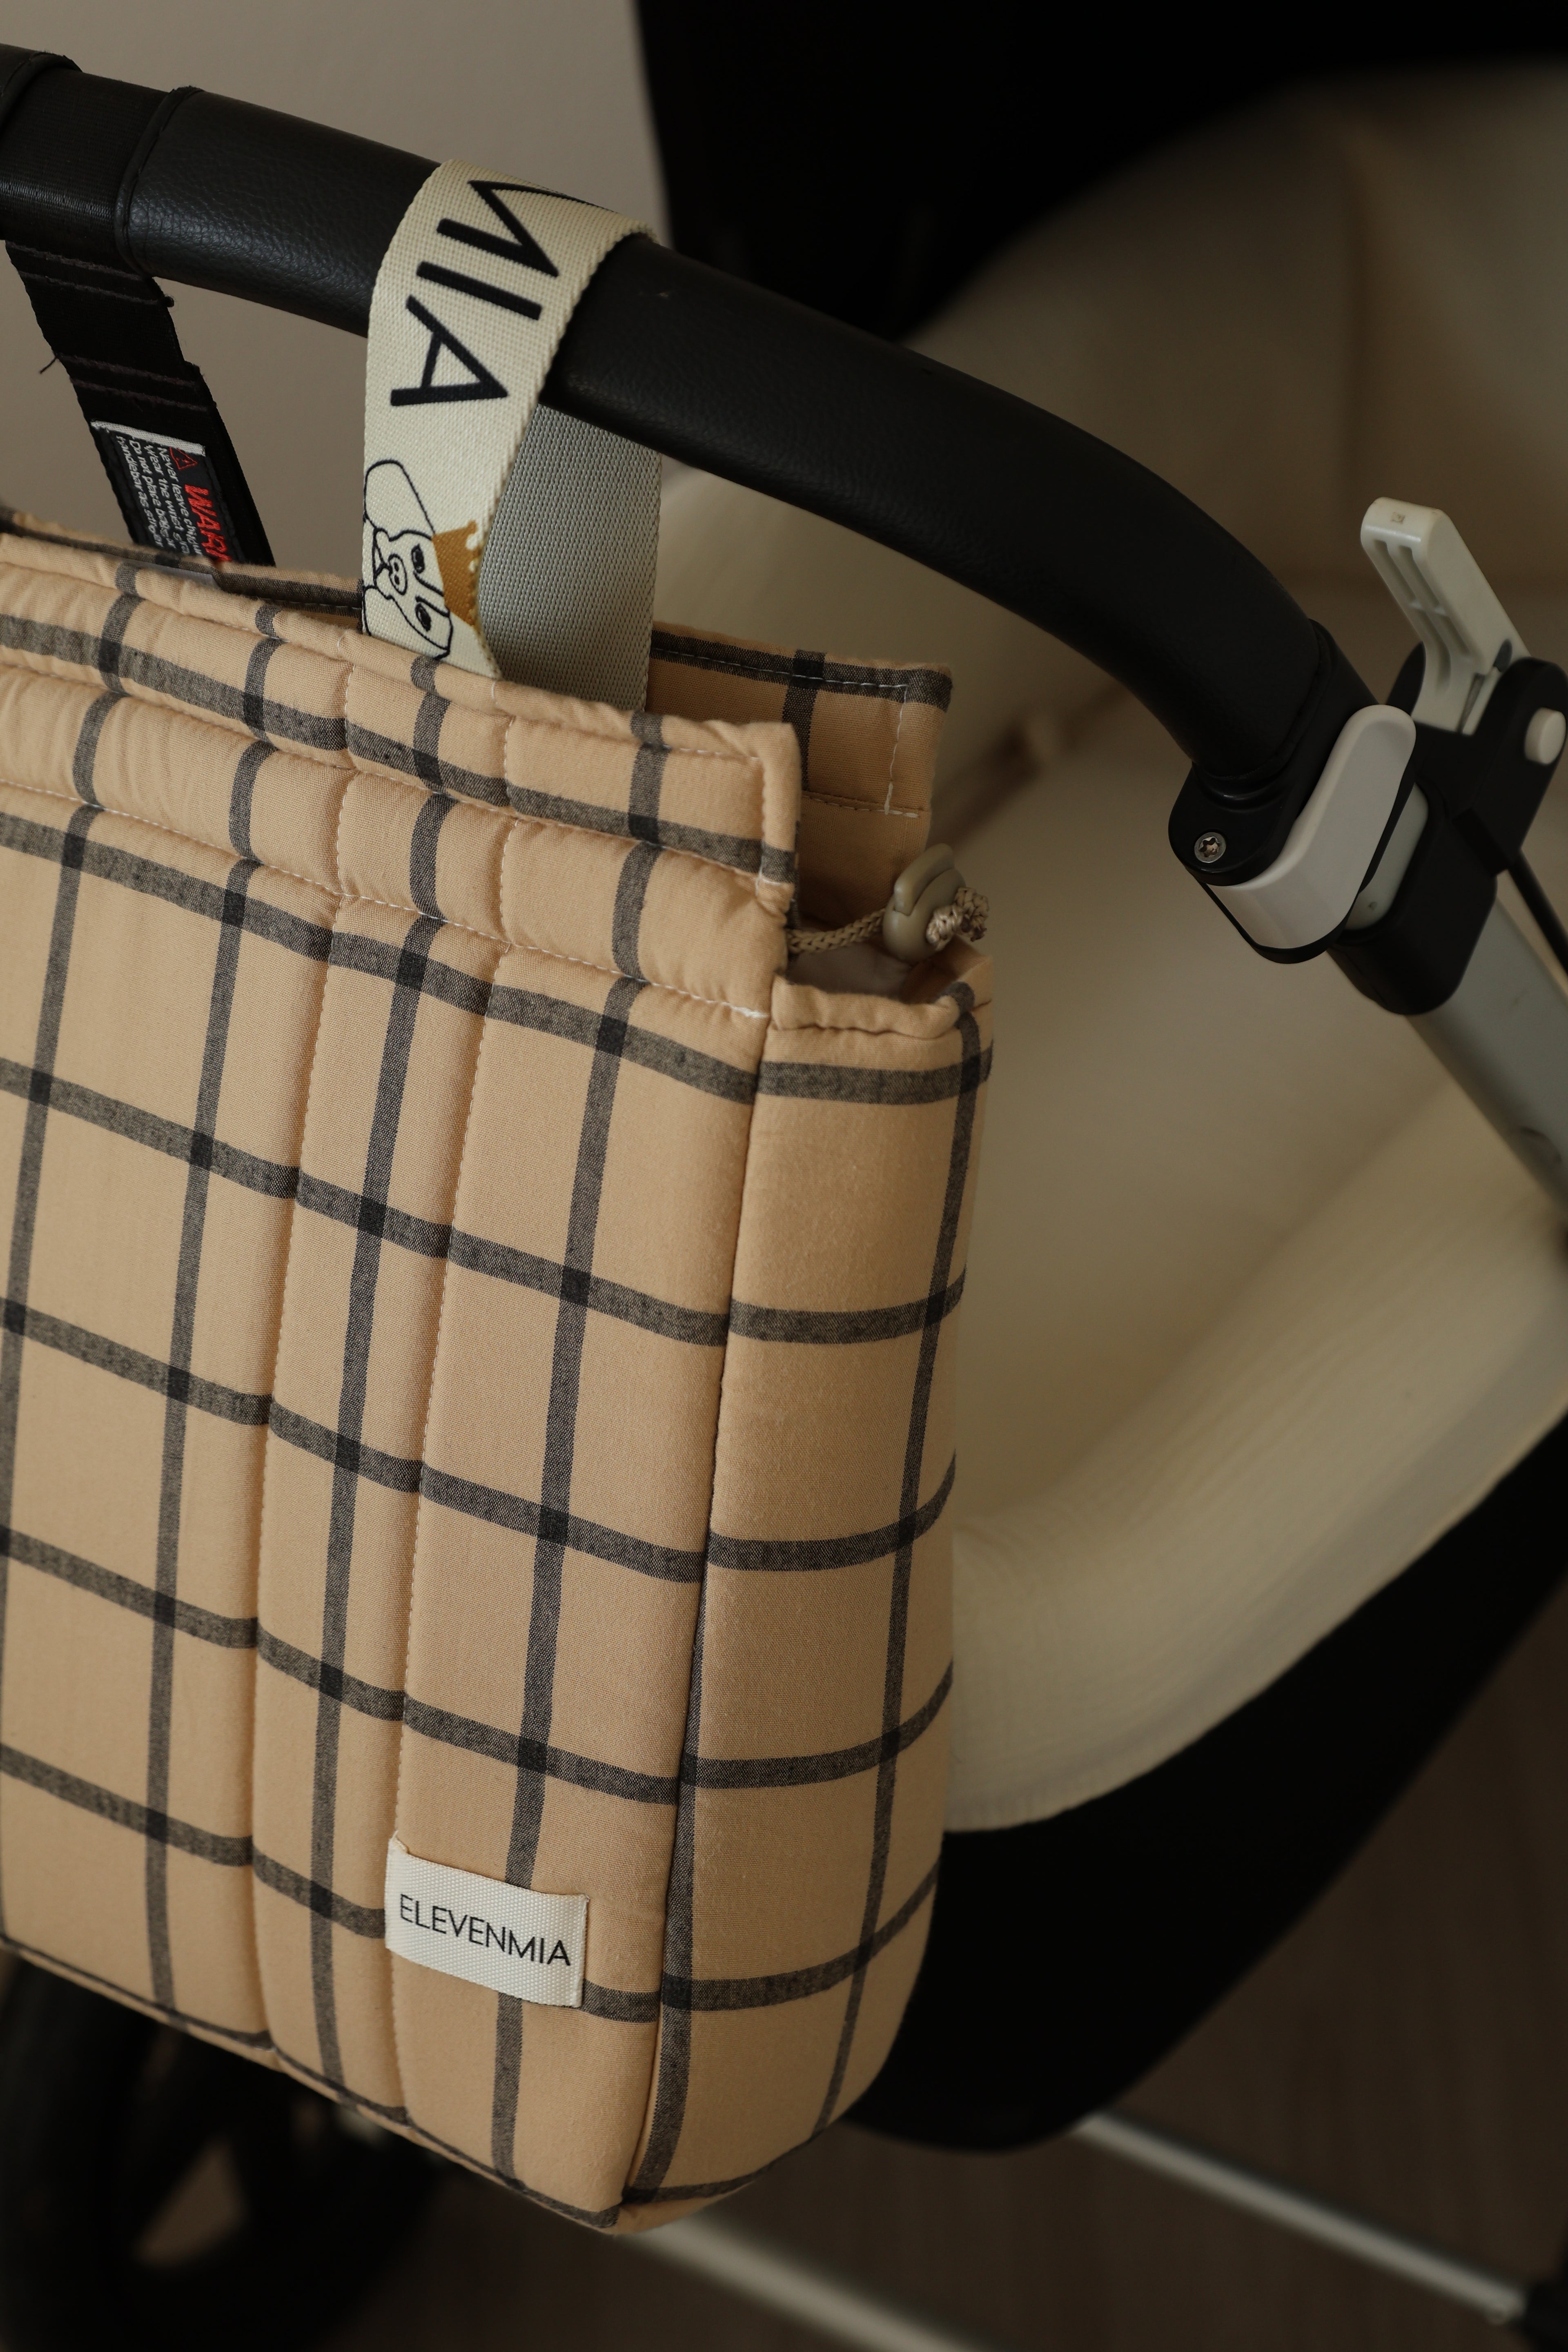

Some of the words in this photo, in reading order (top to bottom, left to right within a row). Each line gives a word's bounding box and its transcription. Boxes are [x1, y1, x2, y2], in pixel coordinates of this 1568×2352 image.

[129, 440, 142, 454] Do
[137, 456, 152, 474] not
[142, 476, 161, 506] place
[144, 445, 163, 474] Wear
[158, 478, 169, 498] the
[165, 500, 183, 530] wrist
[158, 447, 178, 481] Never
[172, 483, 189, 516] leave
[138, 492, 148, 507] as
[401, 1894, 570, 1966] ELEVENMIA
